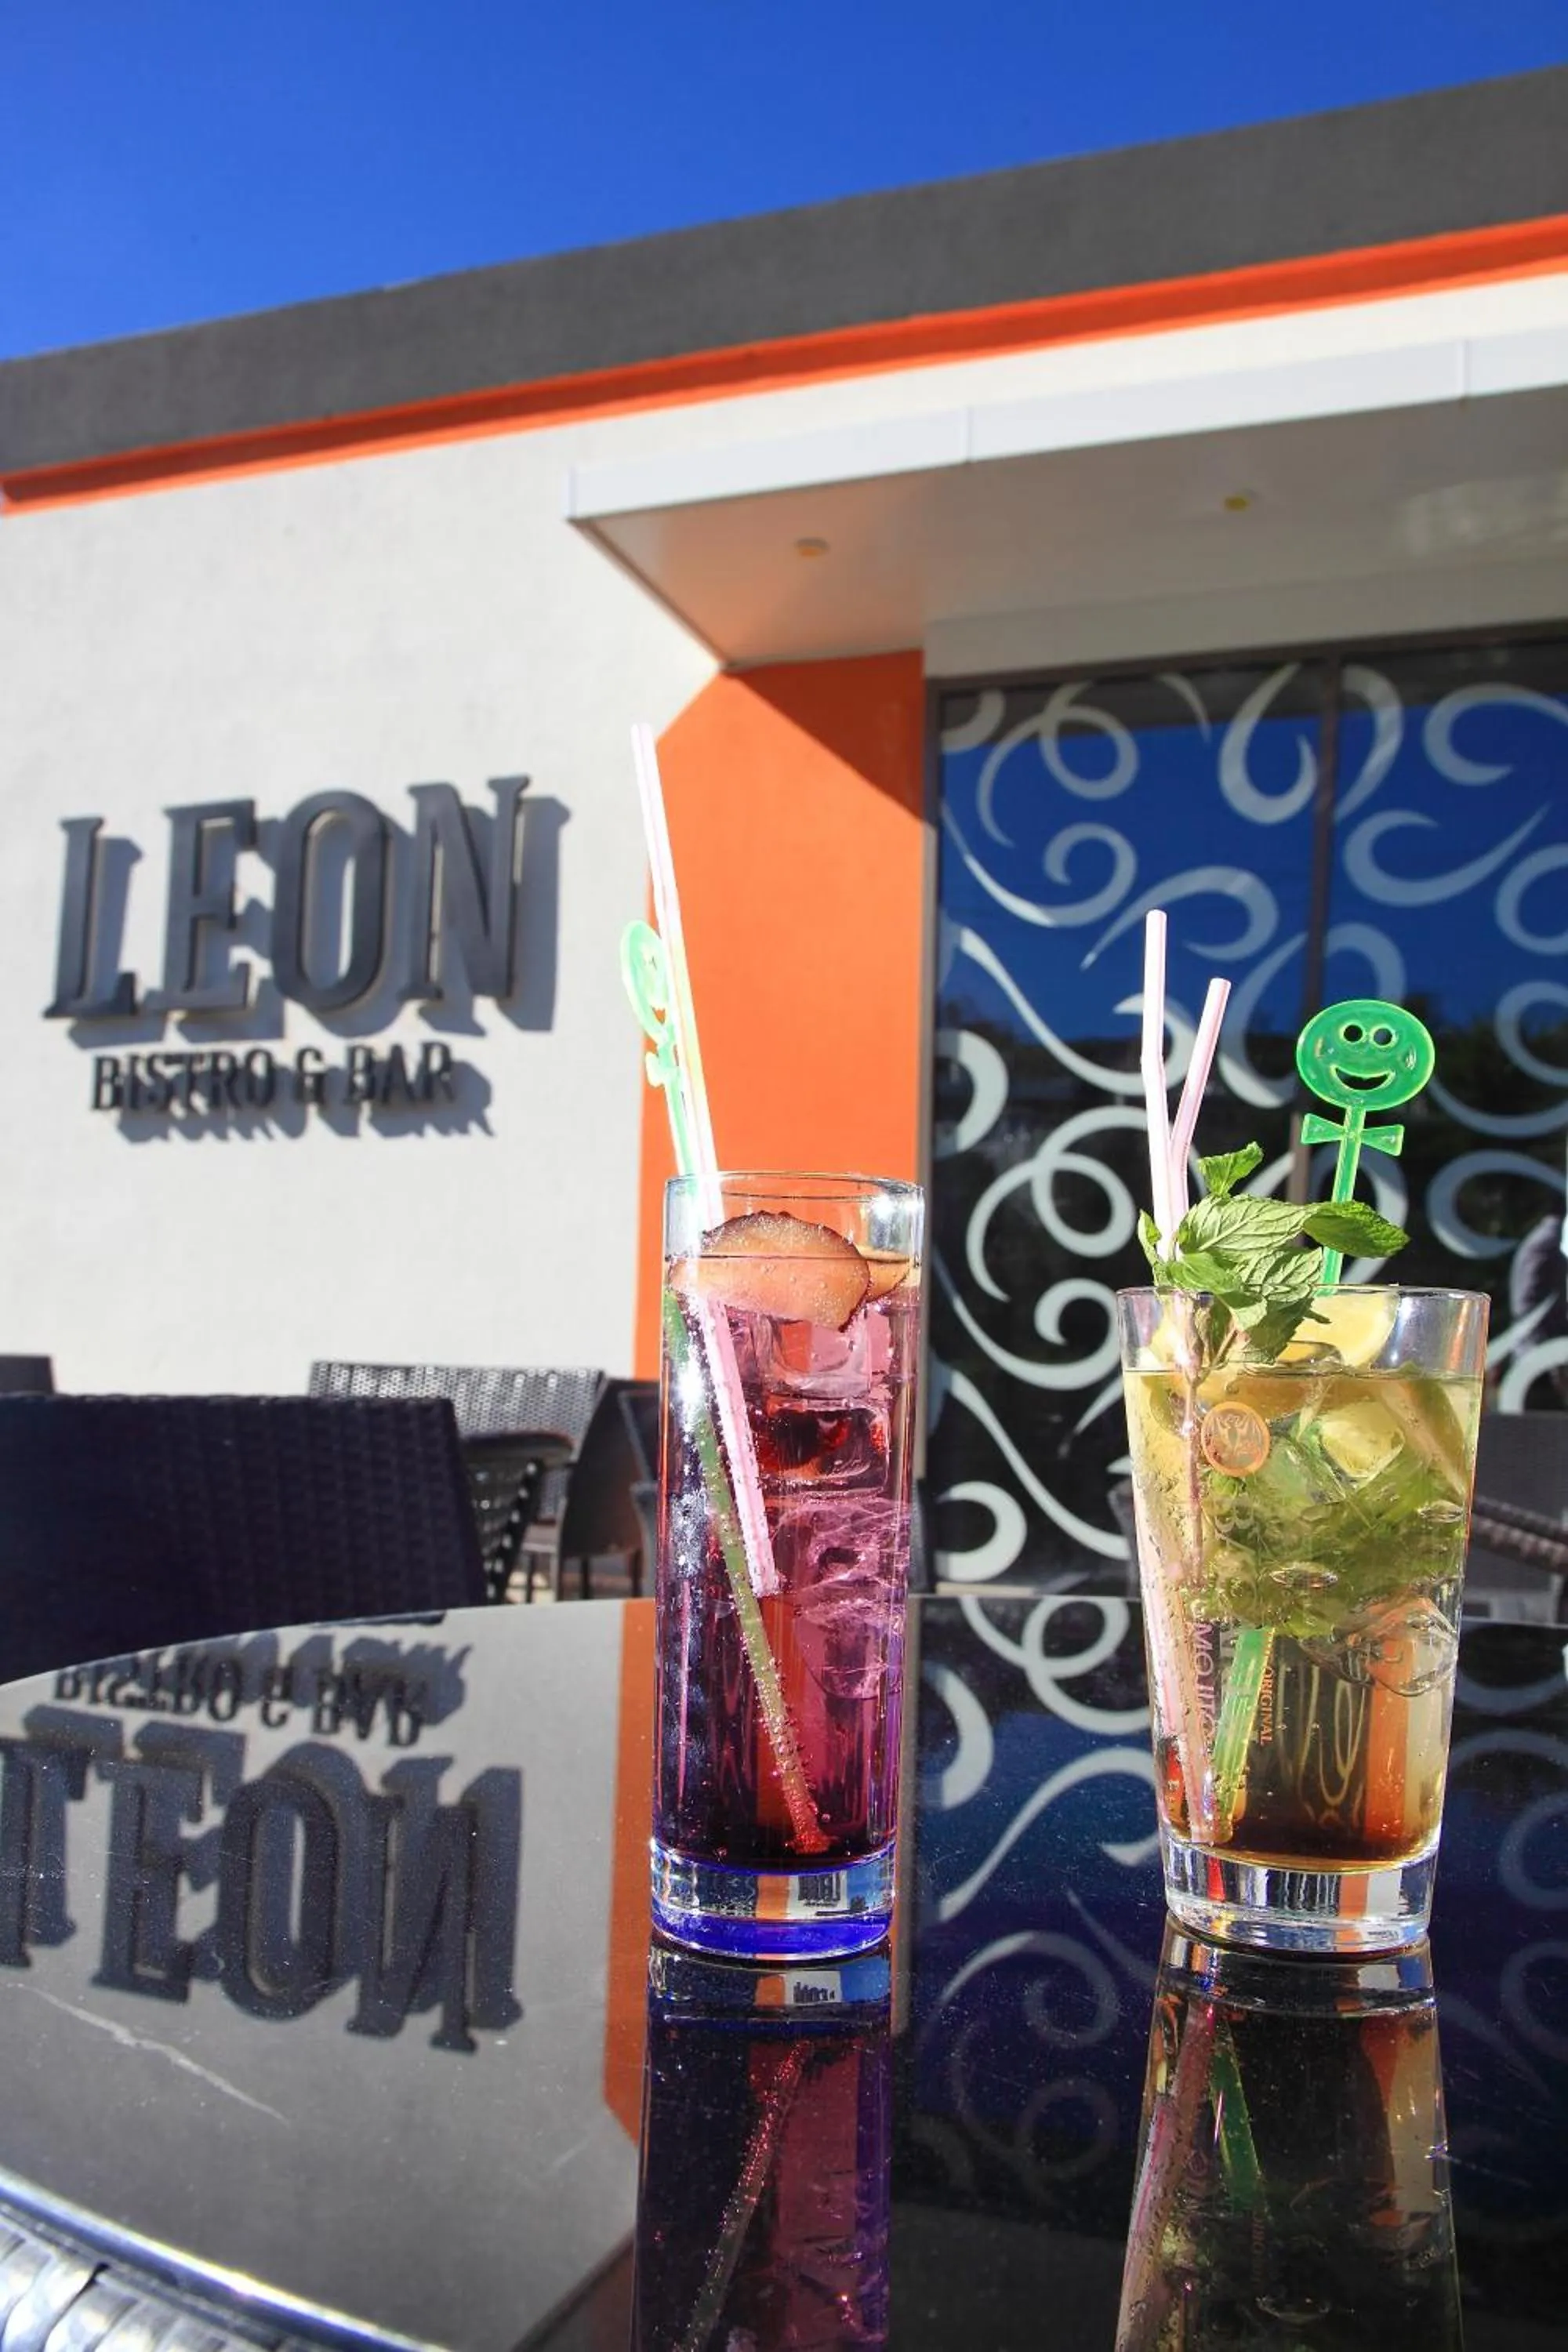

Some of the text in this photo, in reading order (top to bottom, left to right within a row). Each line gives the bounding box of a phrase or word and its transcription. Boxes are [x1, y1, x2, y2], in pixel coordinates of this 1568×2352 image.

[43, 775, 531, 1021] LEON
[91, 1047, 277, 1112] BISTRO
[345, 1041, 456, 1106] BAR
[1193, 1622, 1218, 1736] MOJITO
[1261, 1668, 1274, 1746] ORIGINAL
